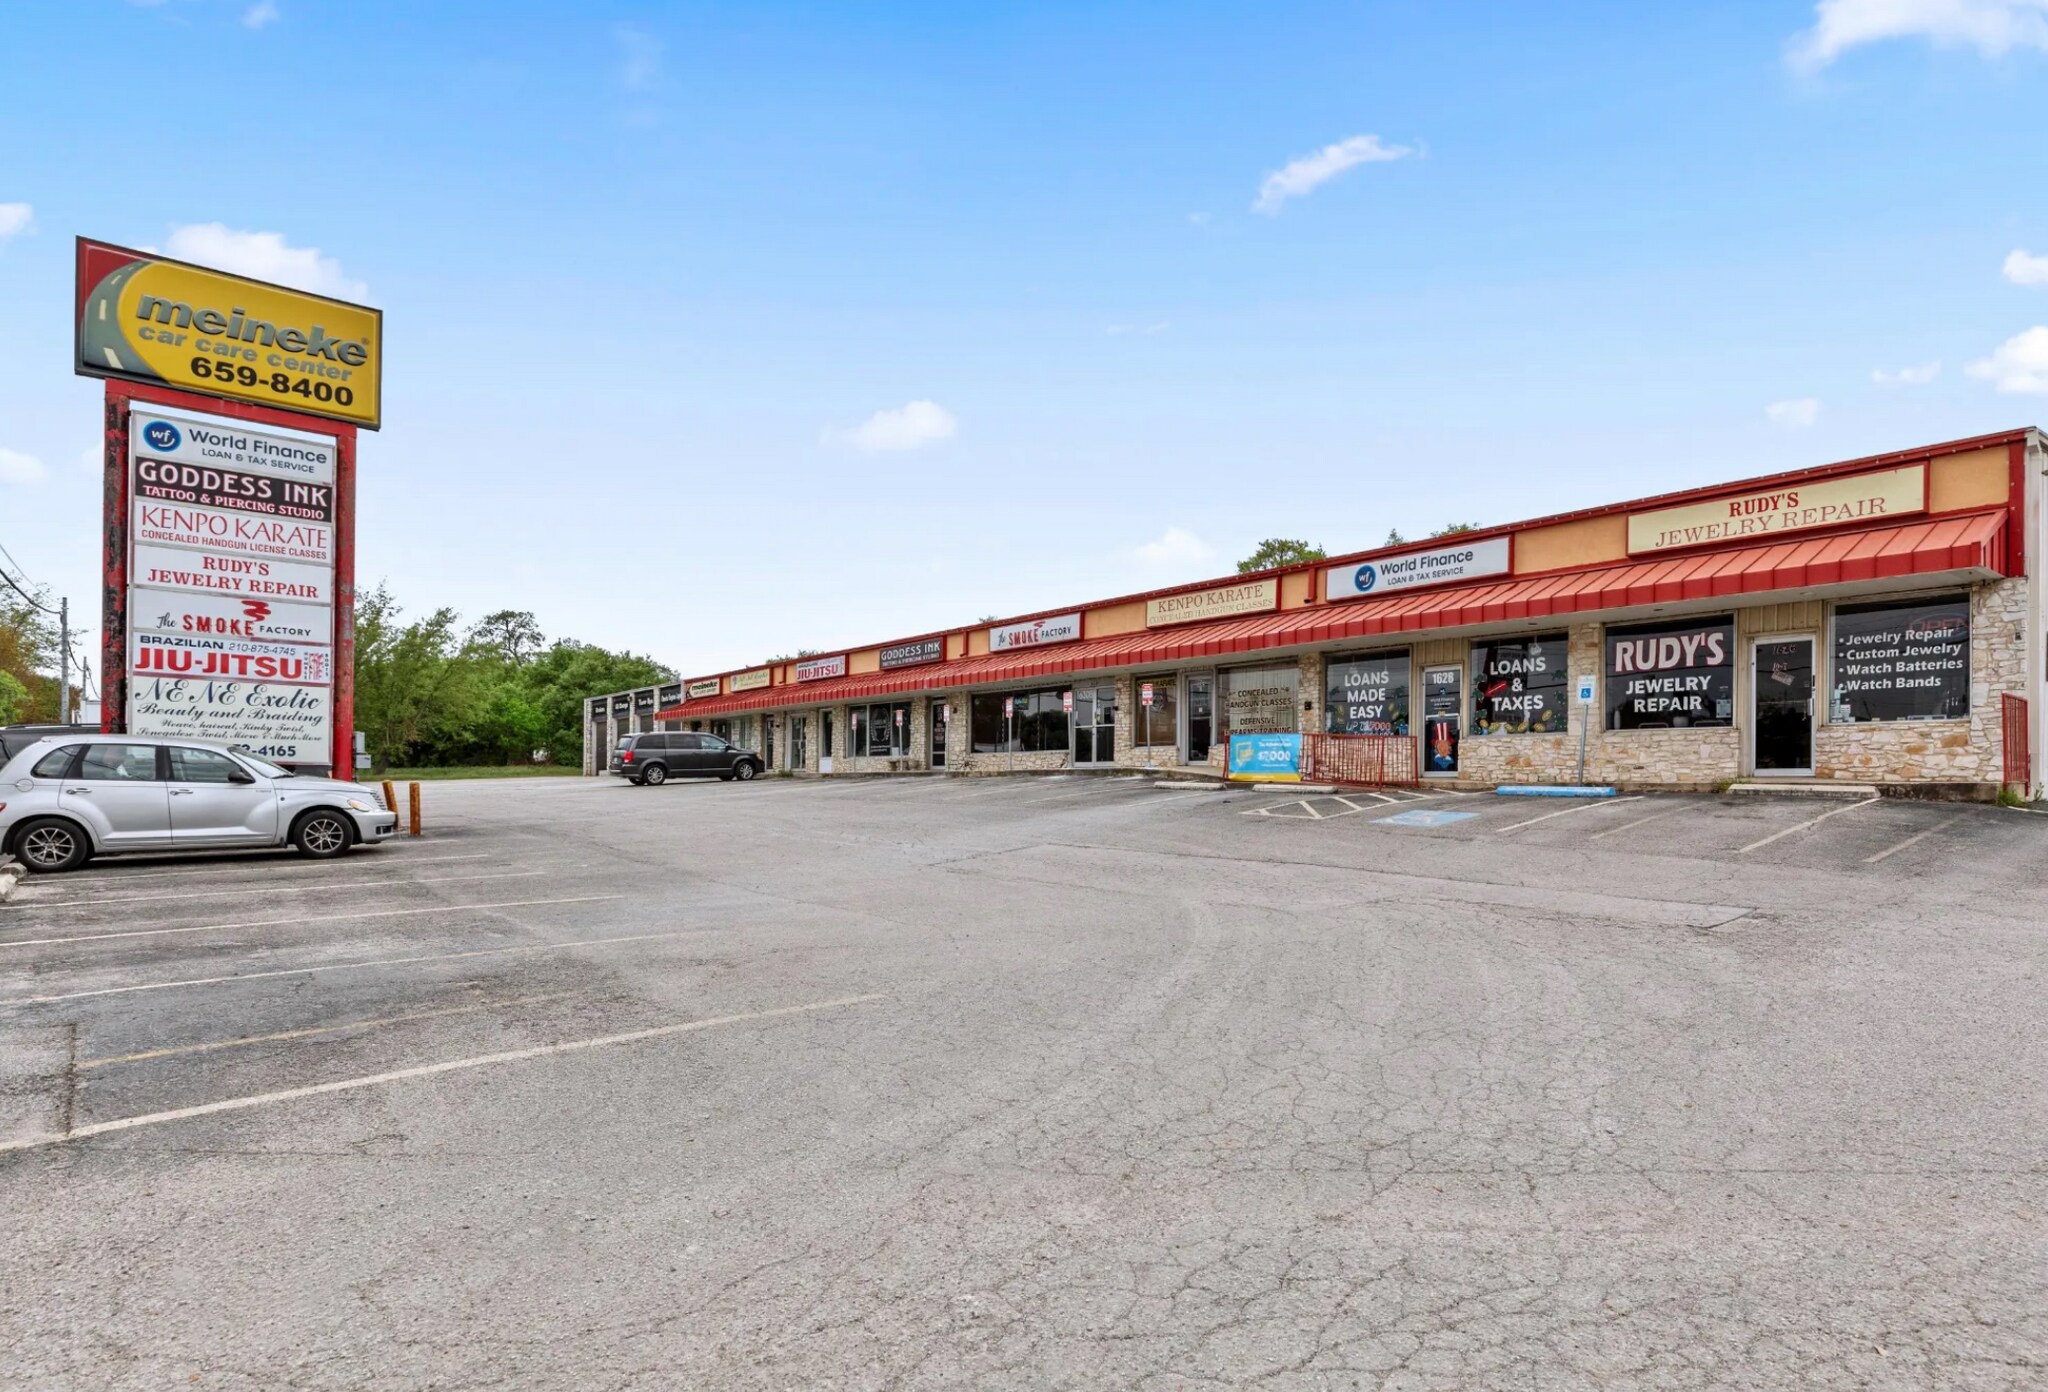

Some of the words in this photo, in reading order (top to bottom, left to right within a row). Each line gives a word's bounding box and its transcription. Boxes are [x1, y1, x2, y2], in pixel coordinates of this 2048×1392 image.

[136, 293, 368, 366] meineke
[138, 325, 186, 346] car
[195, 338, 257, 362] care
[267, 352, 352, 381] center
[190, 356, 353, 407] 659-8400
[189, 429, 247, 450] World
[253, 440, 327, 464] Finance
[202, 448, 232, 460] LOAN
[236, 453, 244, 461] &
[248, 456, 268, 466] TAX
[271, 459, 315, 473] SERVICE
[139, 461, 272, 498] GODDESS
[284, 483, 328, 507] INK
[142, 485, 196, 501] TATTOO
[200, 493, 210, 503] &
[215, 495, 275, 513] PIERCING
[278, 505, 324, 520] STUDIO
[1729, 491, 1799, 517] RUDY'S
[141, 505, 228, 535] KENPO
[235, 518, 327, 549] KARATE
[1655, 514, 1775, 547] JEWELRY
[1782, 496, 1888, 529] REPAIR
[141, 529, 198, 544] CONCEALED
[202, 537, 247, 550] HANDGUN
[250, 543, 286, 555] LICENSE
[288, 548, 327, 560] CLASSES
[203, 556, 270, 576] RUDY'S
[1380, 559, 1417, 576] World
[1420, 549, 1474, 568] Finance
[148, 568, 243, 591] JEWELRY
[250, 579, 318, 598] REPAIR
[1387, 575, 1407, 586] LOAN
[1416, 571, 1431, 581] TAX
[1432, 566, 1464, 579] SERVICE
[1158, 594, 1203, 613] KENPO
[1207, 585, 1263, 606] KARATE
[182, 614, 255, 636] SMOKE
[259, 625, 311, 637] FACTORY
[140, 635, 224, 650] BRAZILIAN
[1008, 628, 1039, 646] SMOKE
[1041, 626, 1072, 638] FACTORY
[1846, 632, 1902, 645] Jewelry
[1905, 627, 1954, 642] Repair
[881, 644, 921, 661] GODDESS
[924, 640, 940, 653] INK
[1615, 631, 1725, 673] RUDY'S
[1846, 648, 1899, 660] Custom
[1902, 643, 1962, 656] Jewelry
[135, 647, 302, 679] JIU-JITSU
[797, 663, 839, 680] JIU-JITSU
[1490, 656, 1546, 675] LOANS
[1846, 662, 1892, 675] Watch
[1896, 659, 1963, 672] Batteries
[1344, 670, 1389, 687] LOANS
[1432, 671, 1455, 684] 1628
[1511, 677, 1523, 692] &
[1625, 675, 1712, 695] JEWELRY
[1846, 678, 1892, 691] Watch
[1895, 676, 1942, 688] Bands
[246, 683, 323, 710] Exotic
[1238, 687, 1279, 698] CONCEALED
[1261, 698, 1292, 707] CLASSES
[1347, 687, 1386, 703] MADE
[1349, 704, 1383, 719] EASY
[1491, 694, 1544, 712] TAXES
[1634, 696, 1702, 713] REPAIR
[137, 703, 204, 721] Beauty
[209, 707, 244, 719] and
[247, 708, 325, 726] Braiding
[1240, 717, 1275, 725] DEFENSIVE
[234, 744, 296, 757] -4165
